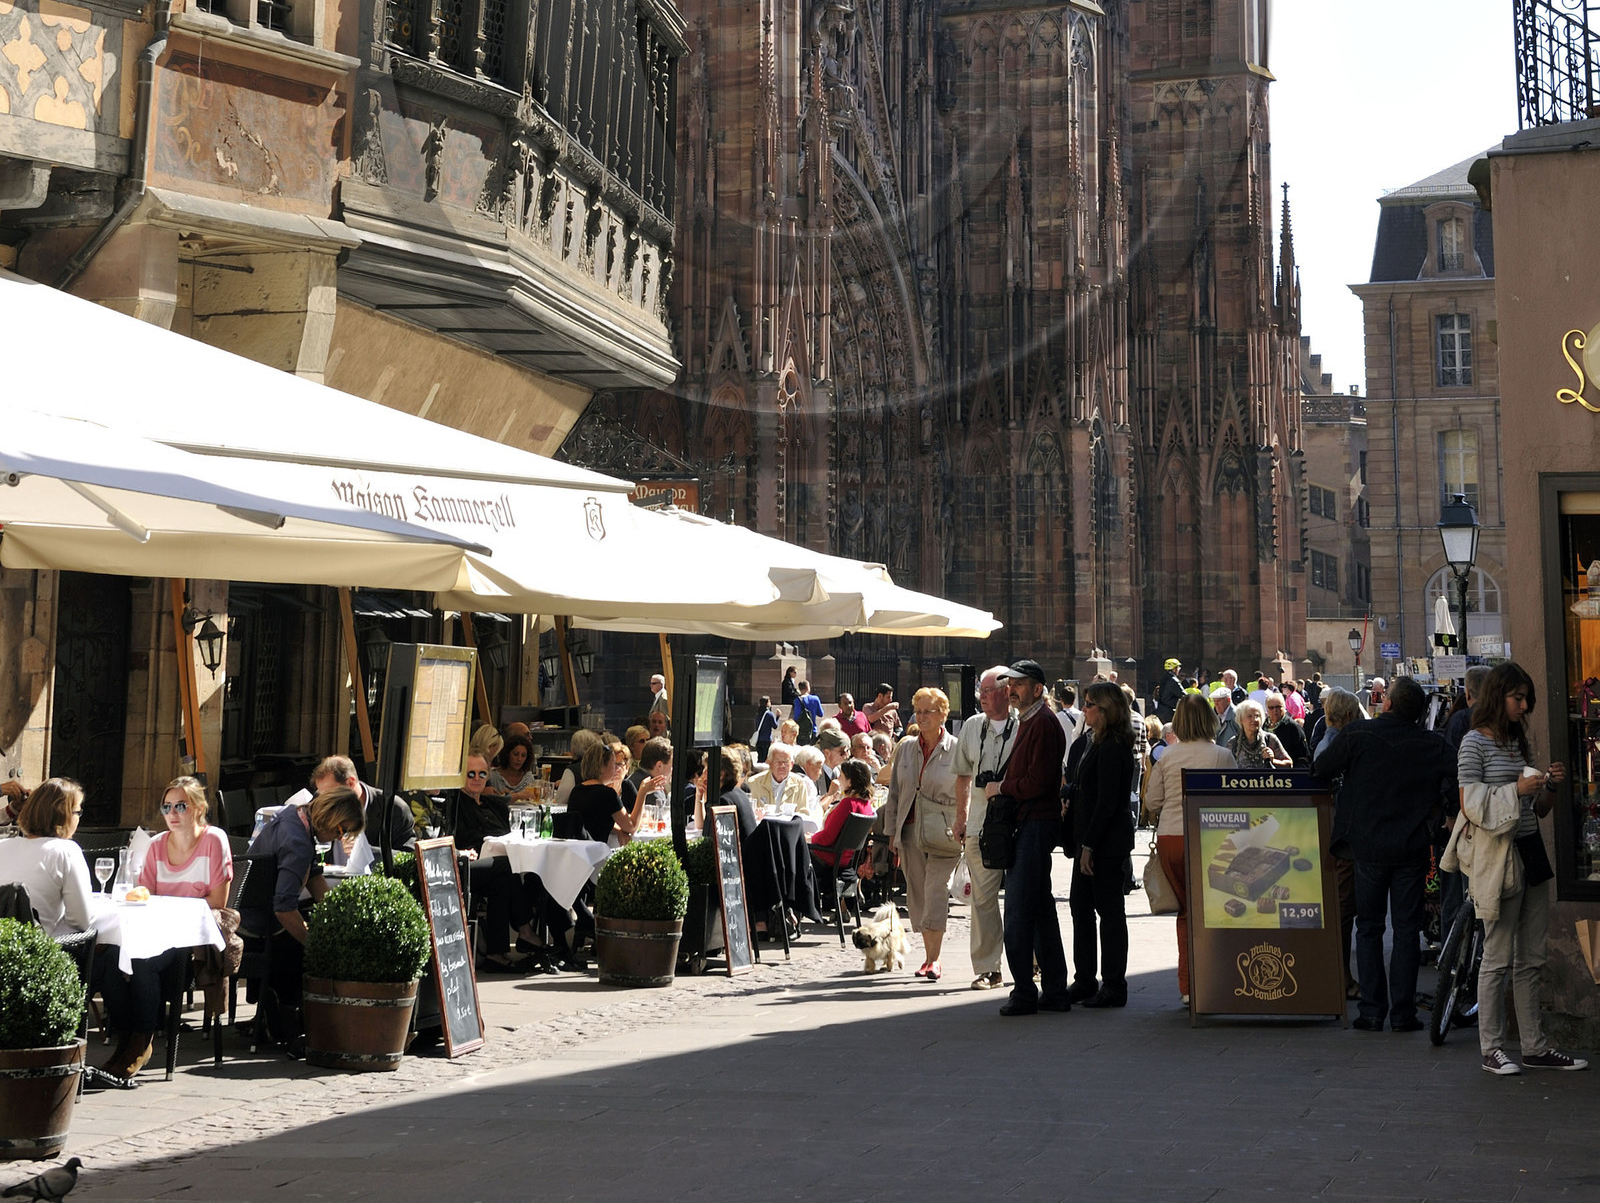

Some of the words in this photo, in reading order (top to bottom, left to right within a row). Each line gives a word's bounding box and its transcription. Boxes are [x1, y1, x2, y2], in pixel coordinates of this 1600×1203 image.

[412, 484, 516, 533] Kammerzell
[1221, 774, 1293, 789] Leonidas
[1201, 813, 1247, 823] NOUVEAU
[1250, 941, 1282, 958] pralines
